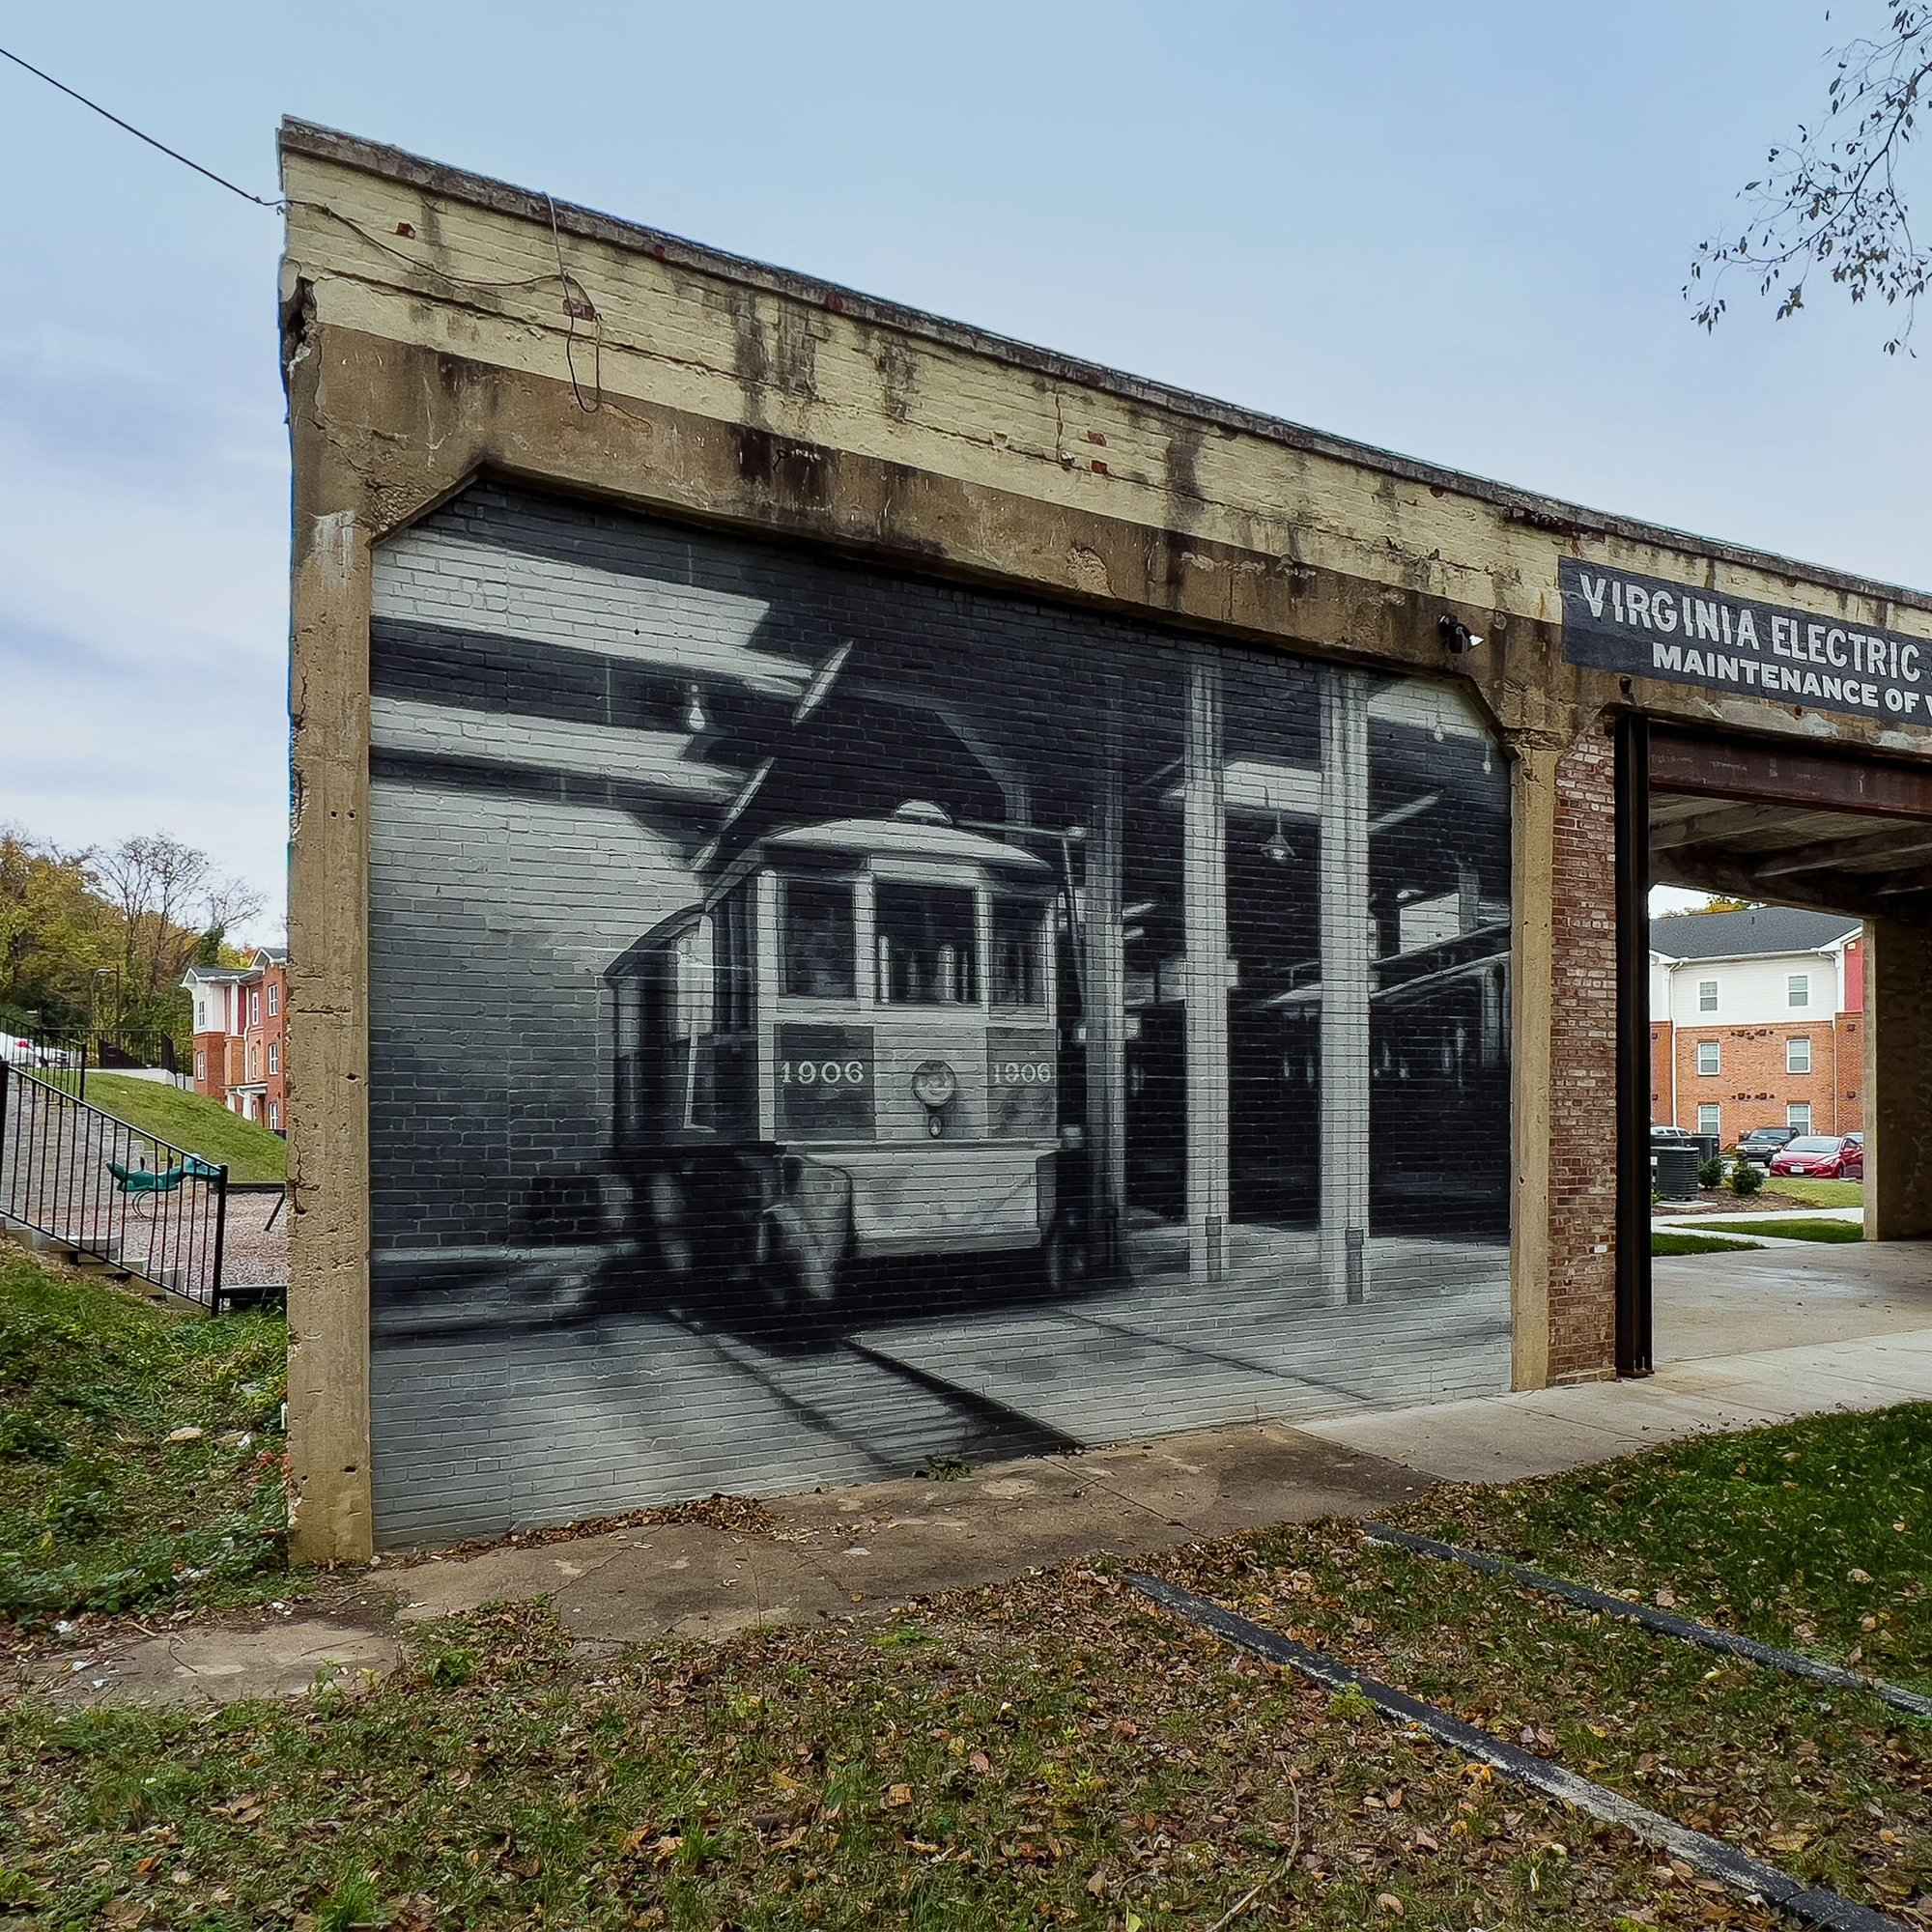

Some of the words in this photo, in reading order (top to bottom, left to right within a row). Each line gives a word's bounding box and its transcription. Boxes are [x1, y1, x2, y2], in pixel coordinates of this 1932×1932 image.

[1579, 572, 1760, 650] VIRGINIA
[1771, 615, 1920, 682] ELECTRIC
[1652, 642, 1879, 707] MAINTENANCE
[1885, 688, 1919, 713] OF
[781, 1062, 865, 1083] 1906
[992, 1063, 1052, 1084] 1906
